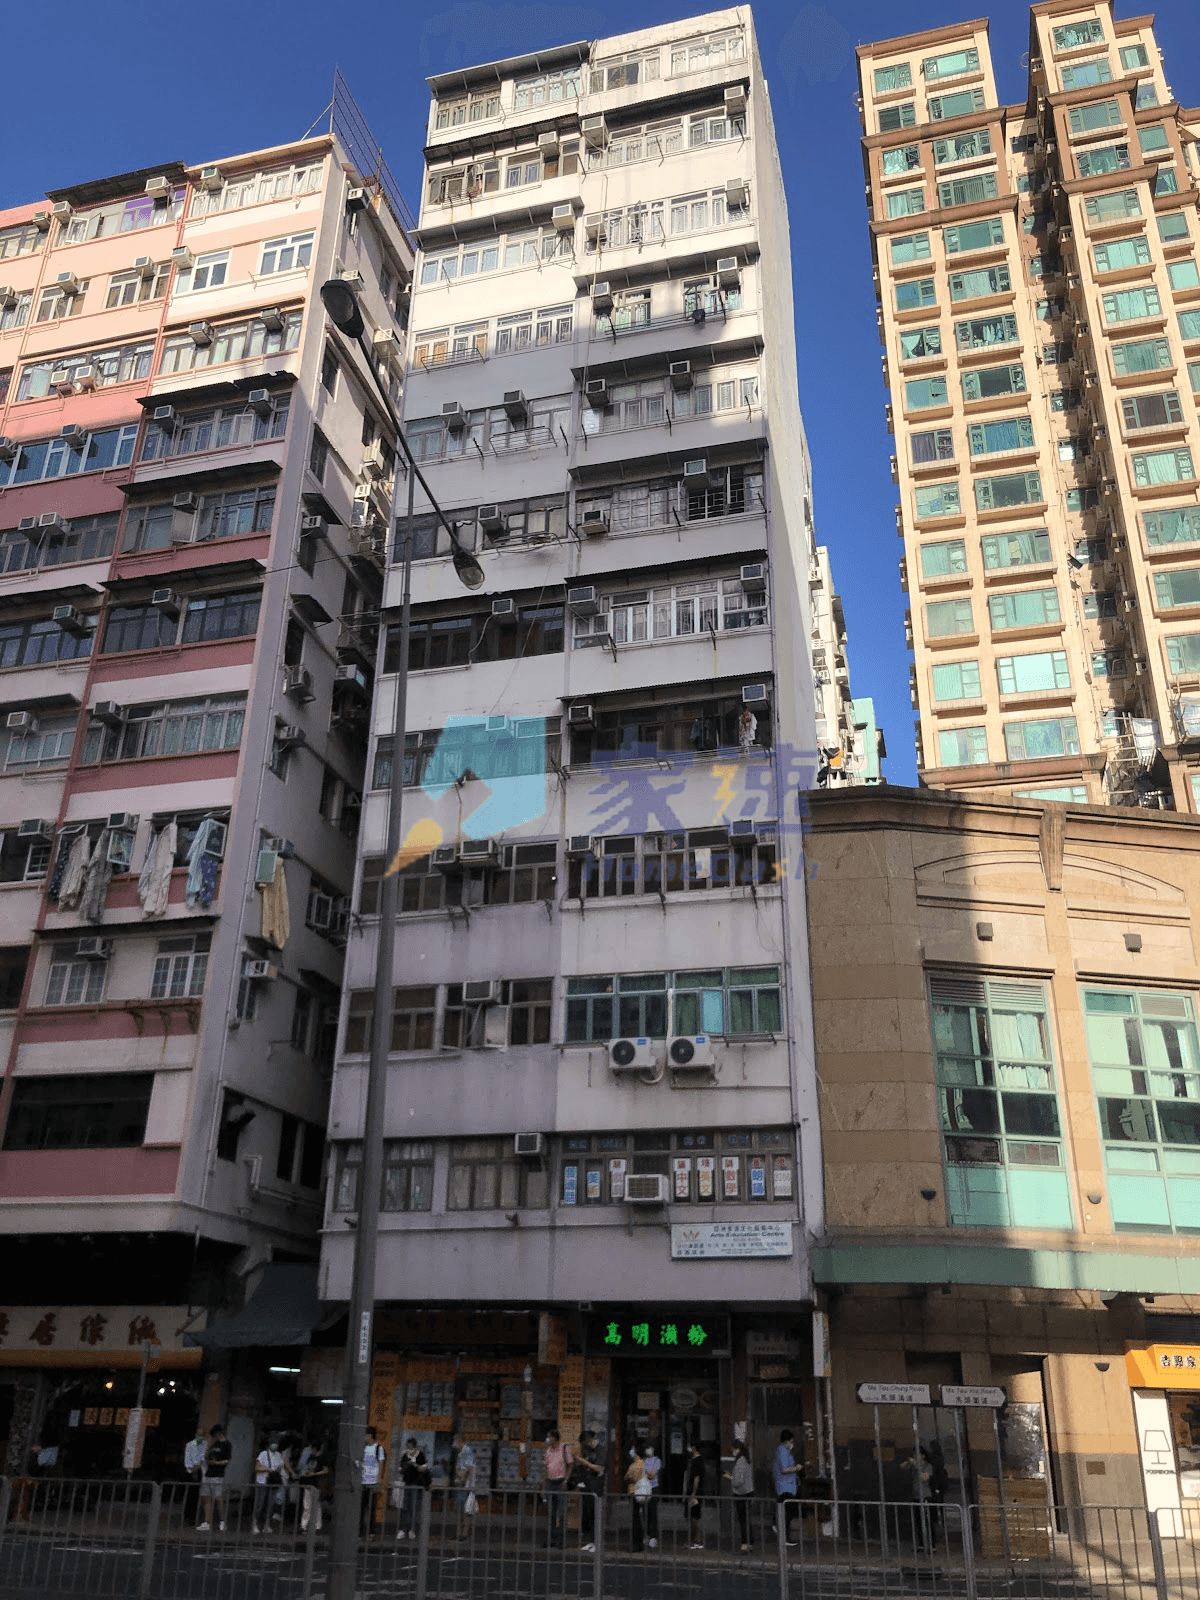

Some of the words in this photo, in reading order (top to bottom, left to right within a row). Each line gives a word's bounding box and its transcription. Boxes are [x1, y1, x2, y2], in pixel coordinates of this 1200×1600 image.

[676, 1172, 689, 1196] 中文
[1160, 1354, 1197, 1369] 吉野家
